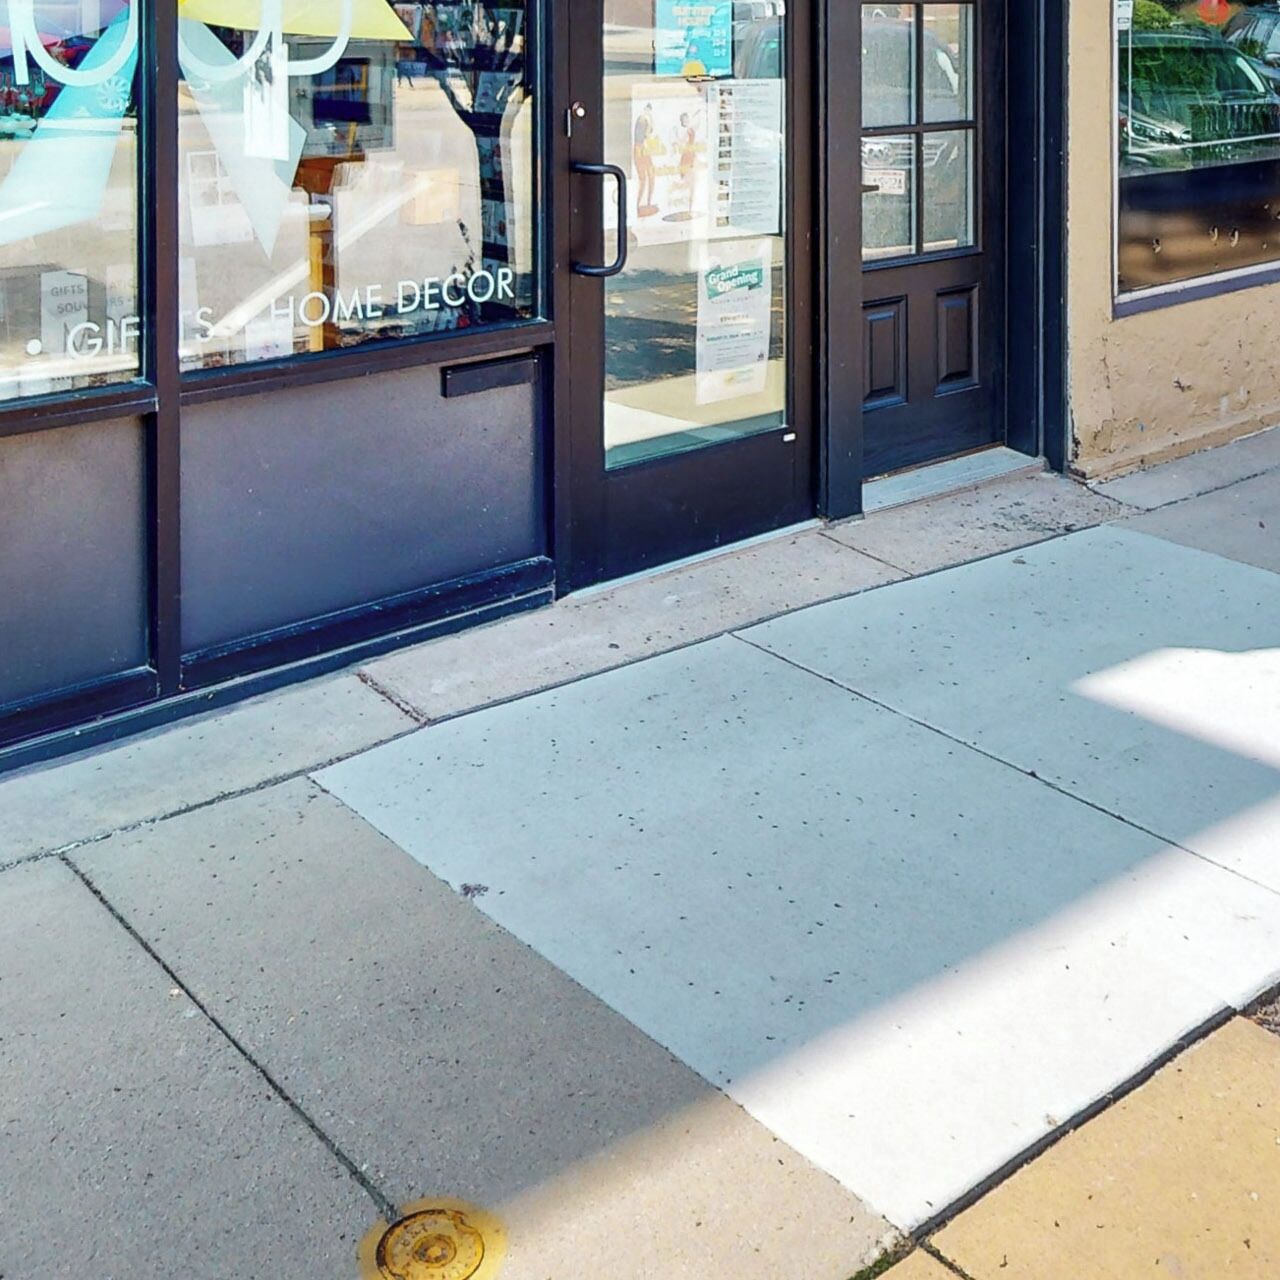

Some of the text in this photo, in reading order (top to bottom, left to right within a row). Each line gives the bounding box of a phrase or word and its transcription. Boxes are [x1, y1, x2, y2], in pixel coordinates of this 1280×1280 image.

[708, 265, 739, 285] Grand
[717, 272, 758, 292] Opening
[51, 284, 84, 297] GIFTS
[271, 284, 381, 326] HOME
[397, 267, 514, 313] DECOR
